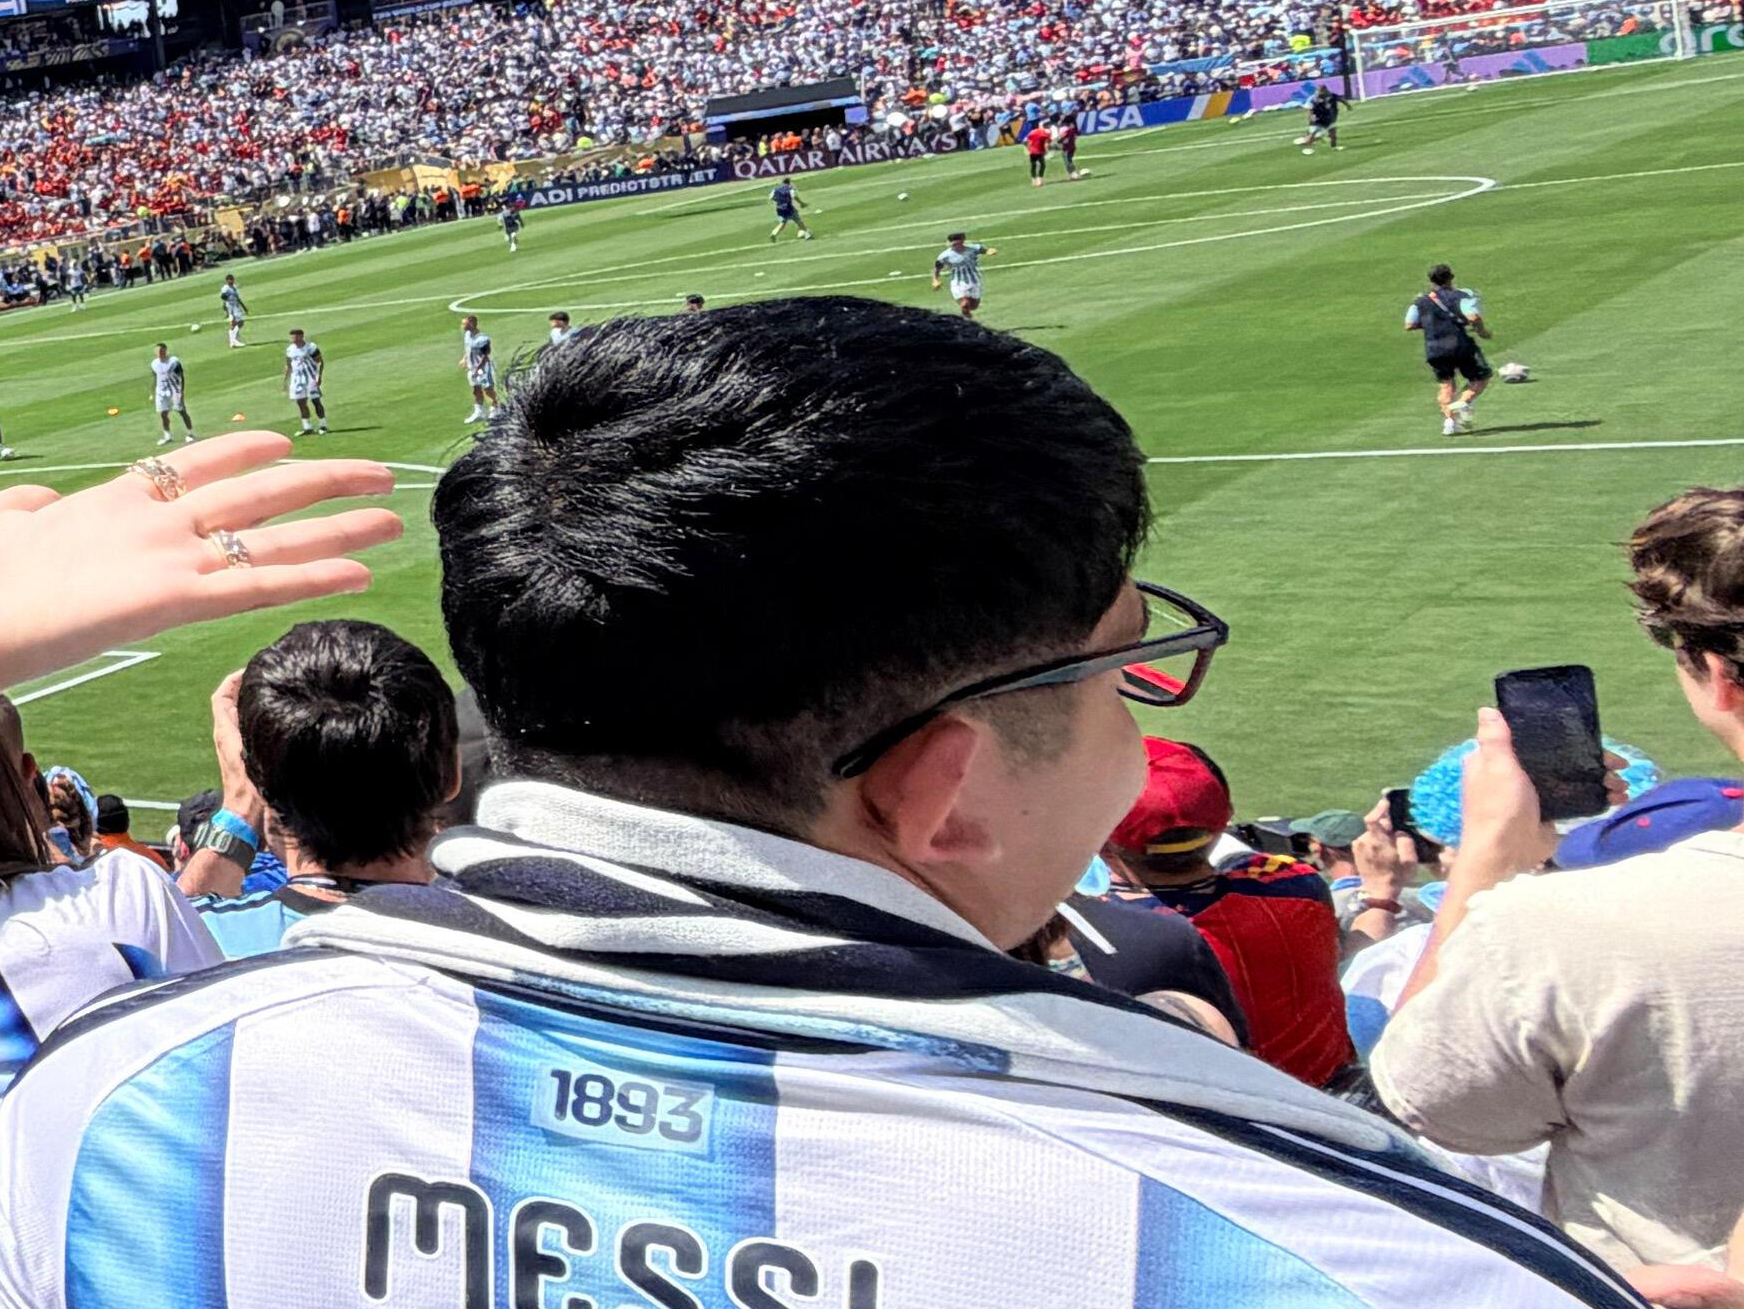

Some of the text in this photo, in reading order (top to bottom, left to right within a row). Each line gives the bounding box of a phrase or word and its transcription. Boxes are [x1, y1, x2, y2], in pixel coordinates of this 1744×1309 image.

[733, 151, 825, 180] QATAR
[529, 167, 719, 207] ADI PREDICTSTRET
[549, 1069, 706, 1146] 1893
